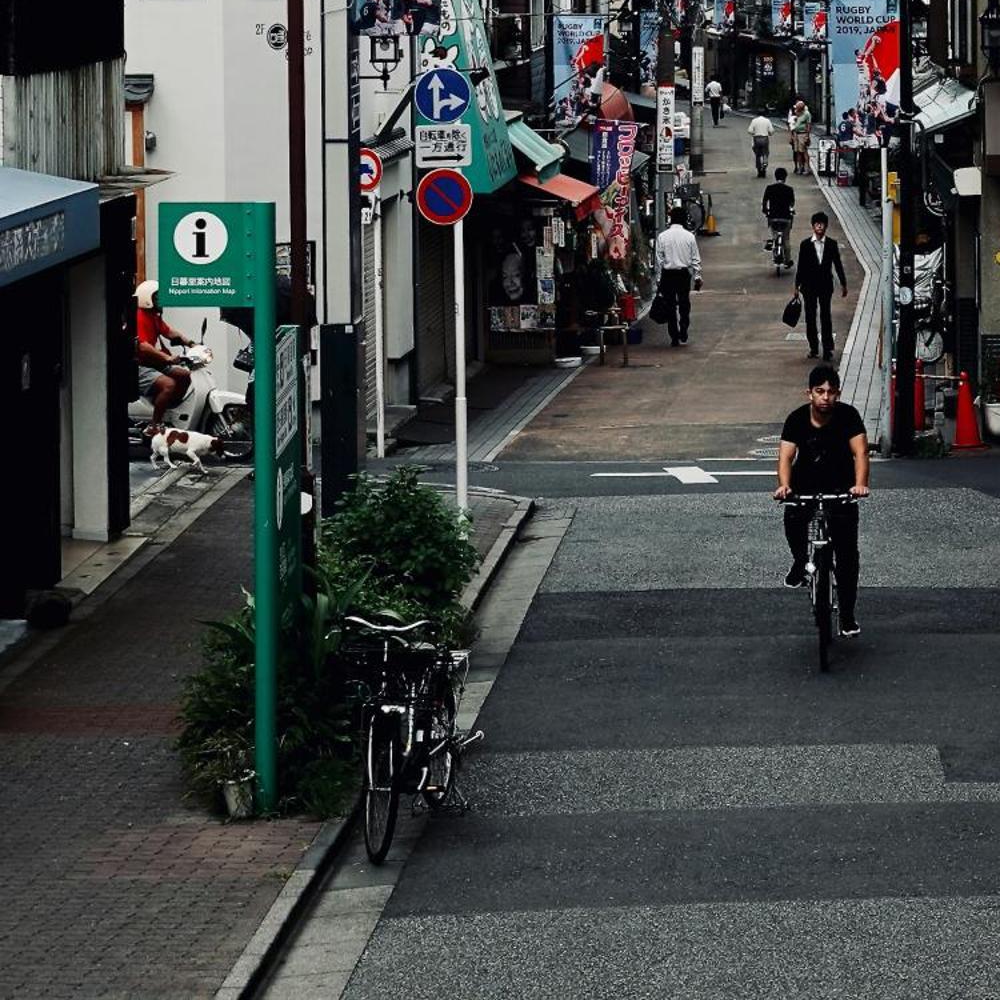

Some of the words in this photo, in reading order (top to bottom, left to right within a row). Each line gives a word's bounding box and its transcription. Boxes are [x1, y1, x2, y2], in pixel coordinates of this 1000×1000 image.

[836, 6, 872, 14] RUGBY
[836, 16, 875, 25] WORLD
[876, 16, 897, 25] CUP
[420, 129, 467, 141] 自転車を除く
[420, 141, 467, 152] 一方通行
